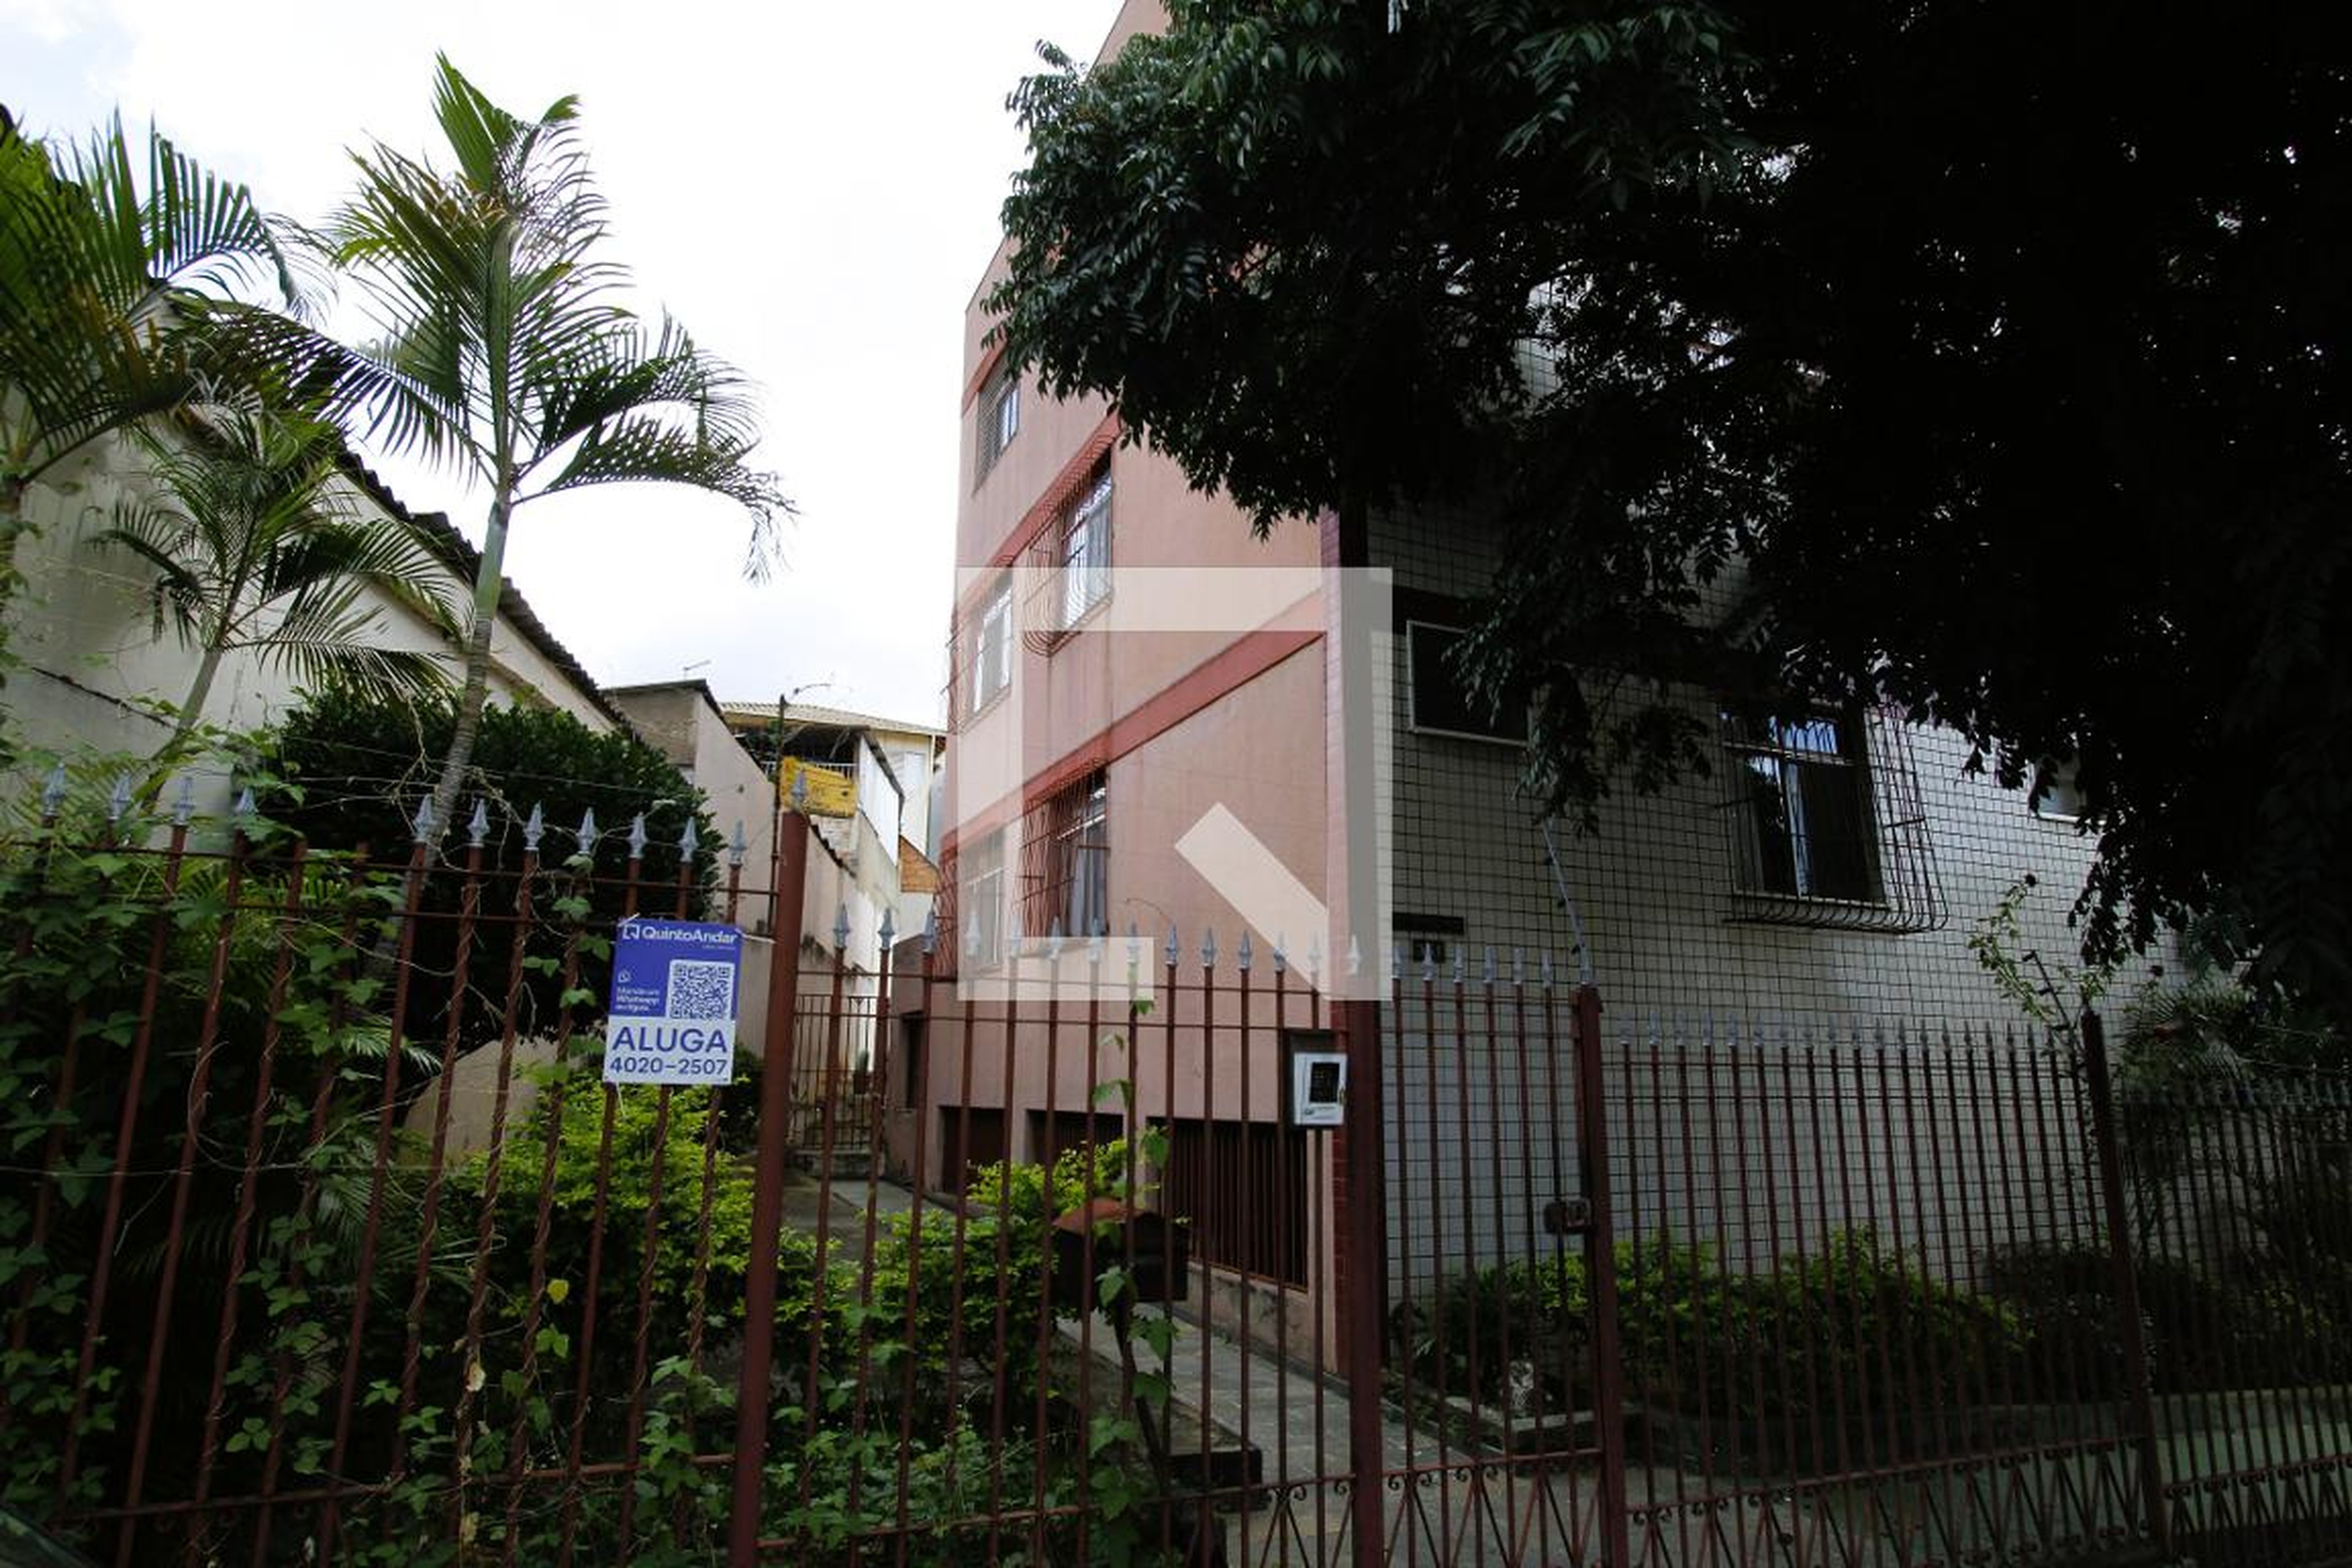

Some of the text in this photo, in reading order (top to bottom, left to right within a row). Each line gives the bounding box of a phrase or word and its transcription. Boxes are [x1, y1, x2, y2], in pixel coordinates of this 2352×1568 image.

[643, 925, 737, 943] QuintoAndar
[612, 1026, 728, 1054] ALUGA
[610, 1057, 728, 1075] 4020-2507
